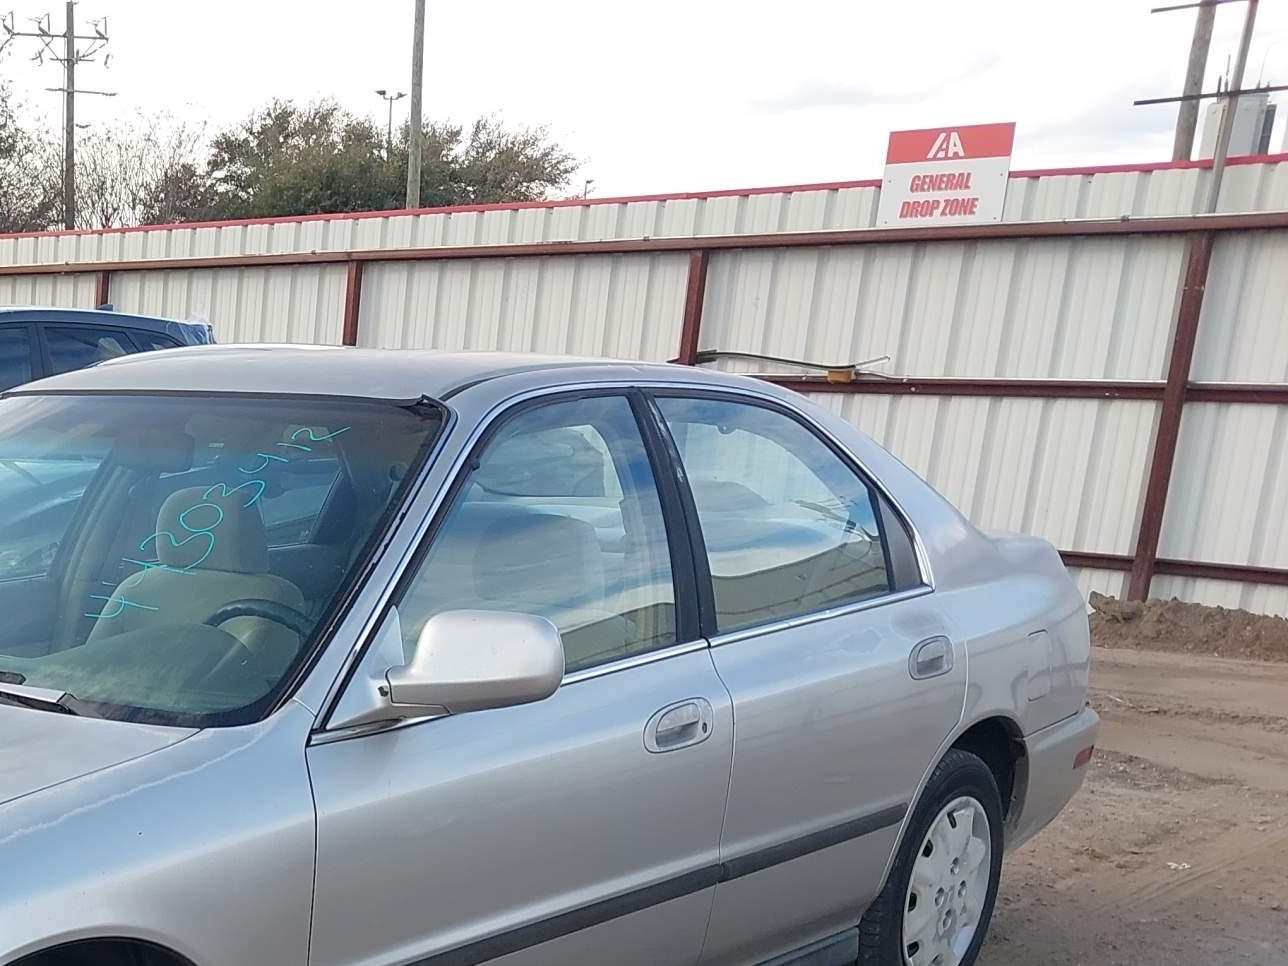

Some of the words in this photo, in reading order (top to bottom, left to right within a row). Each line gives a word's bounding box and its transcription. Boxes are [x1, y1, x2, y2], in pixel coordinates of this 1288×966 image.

[909, 172, 972, 193] GENERAL
[899, 199, 940, 218] DROP
[941, 197, 979, 217] ZONE
